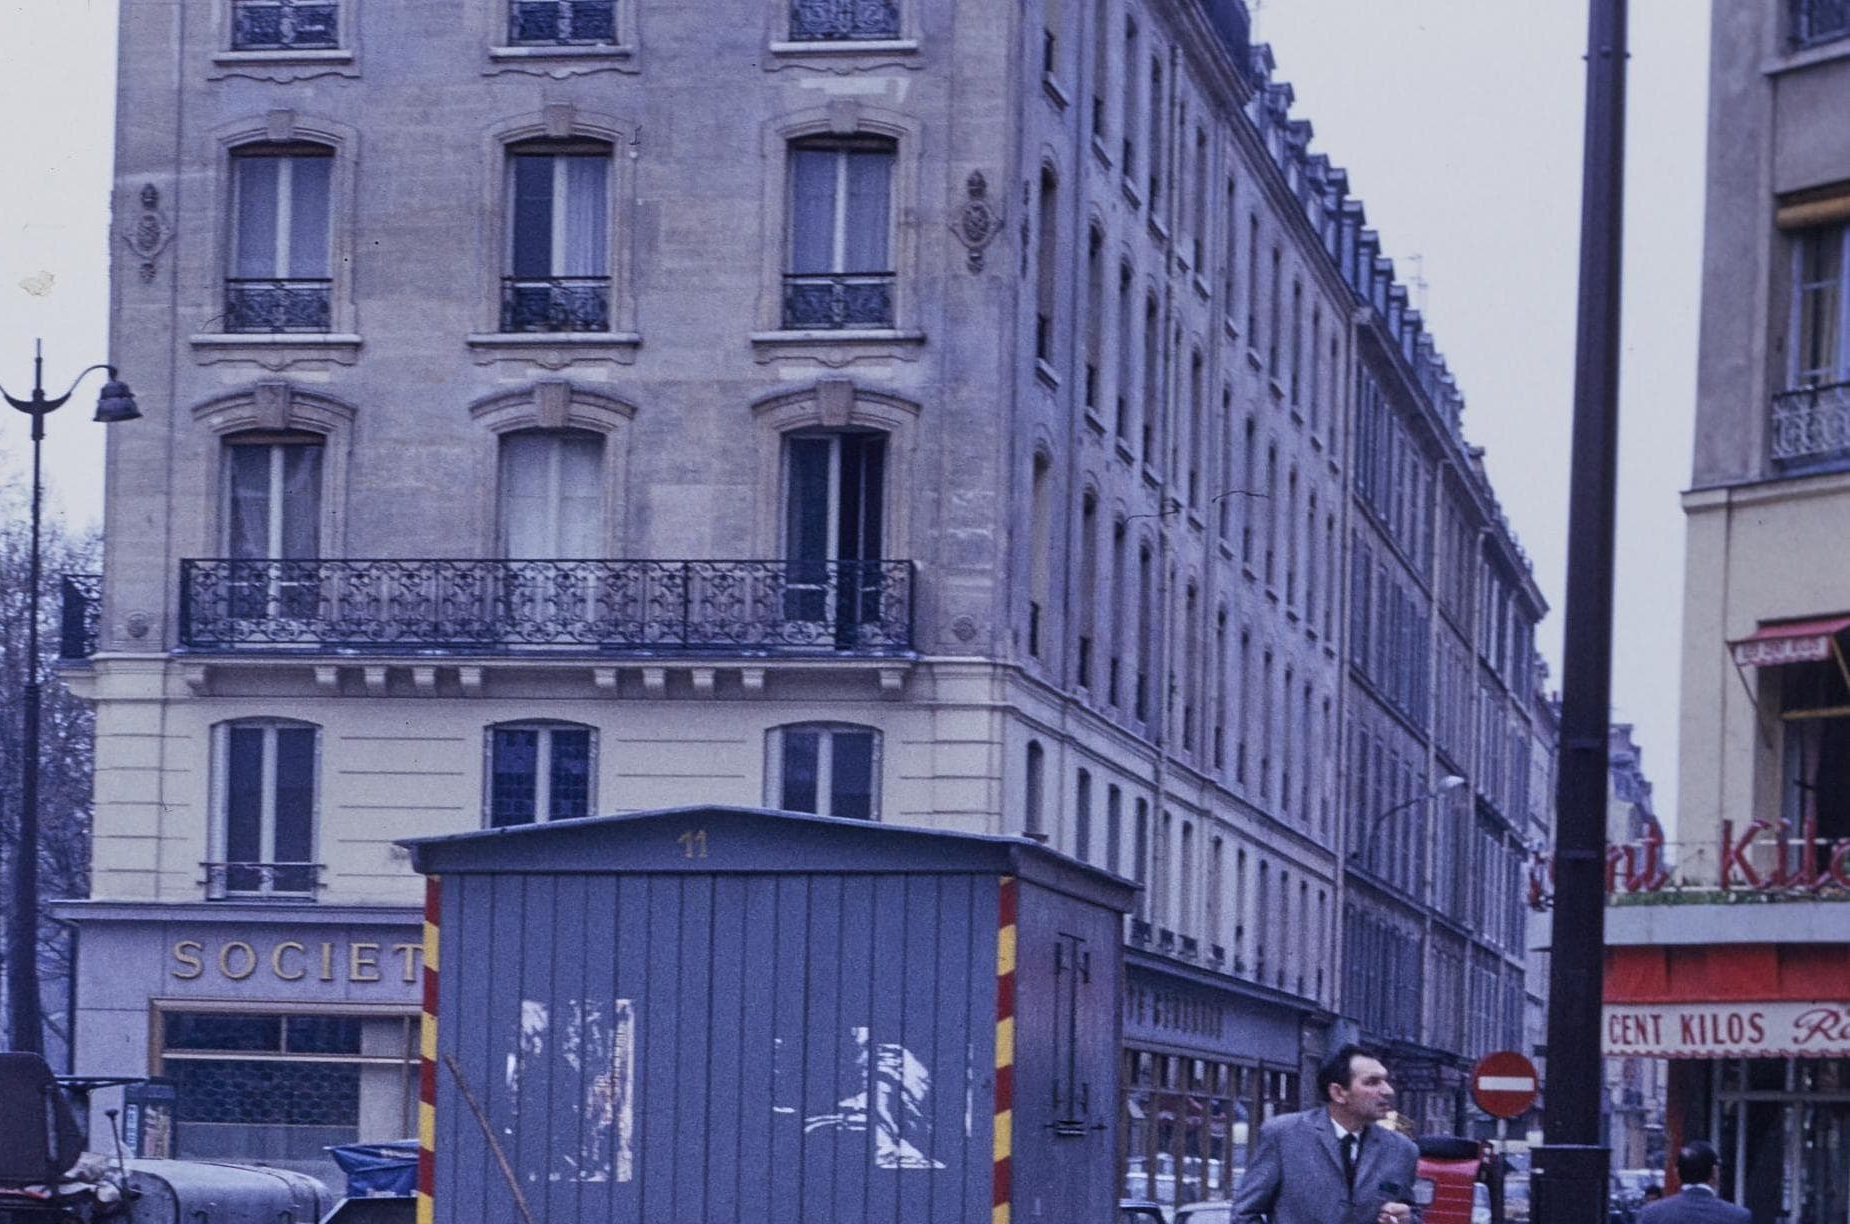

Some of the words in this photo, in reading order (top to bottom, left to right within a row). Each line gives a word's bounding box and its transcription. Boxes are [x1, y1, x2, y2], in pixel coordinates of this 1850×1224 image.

[678, 830, 707, 859] 11
[1609, 1013, 1662, 1045] CENT
[1681, 1012, 1765, 1045] KILOS
